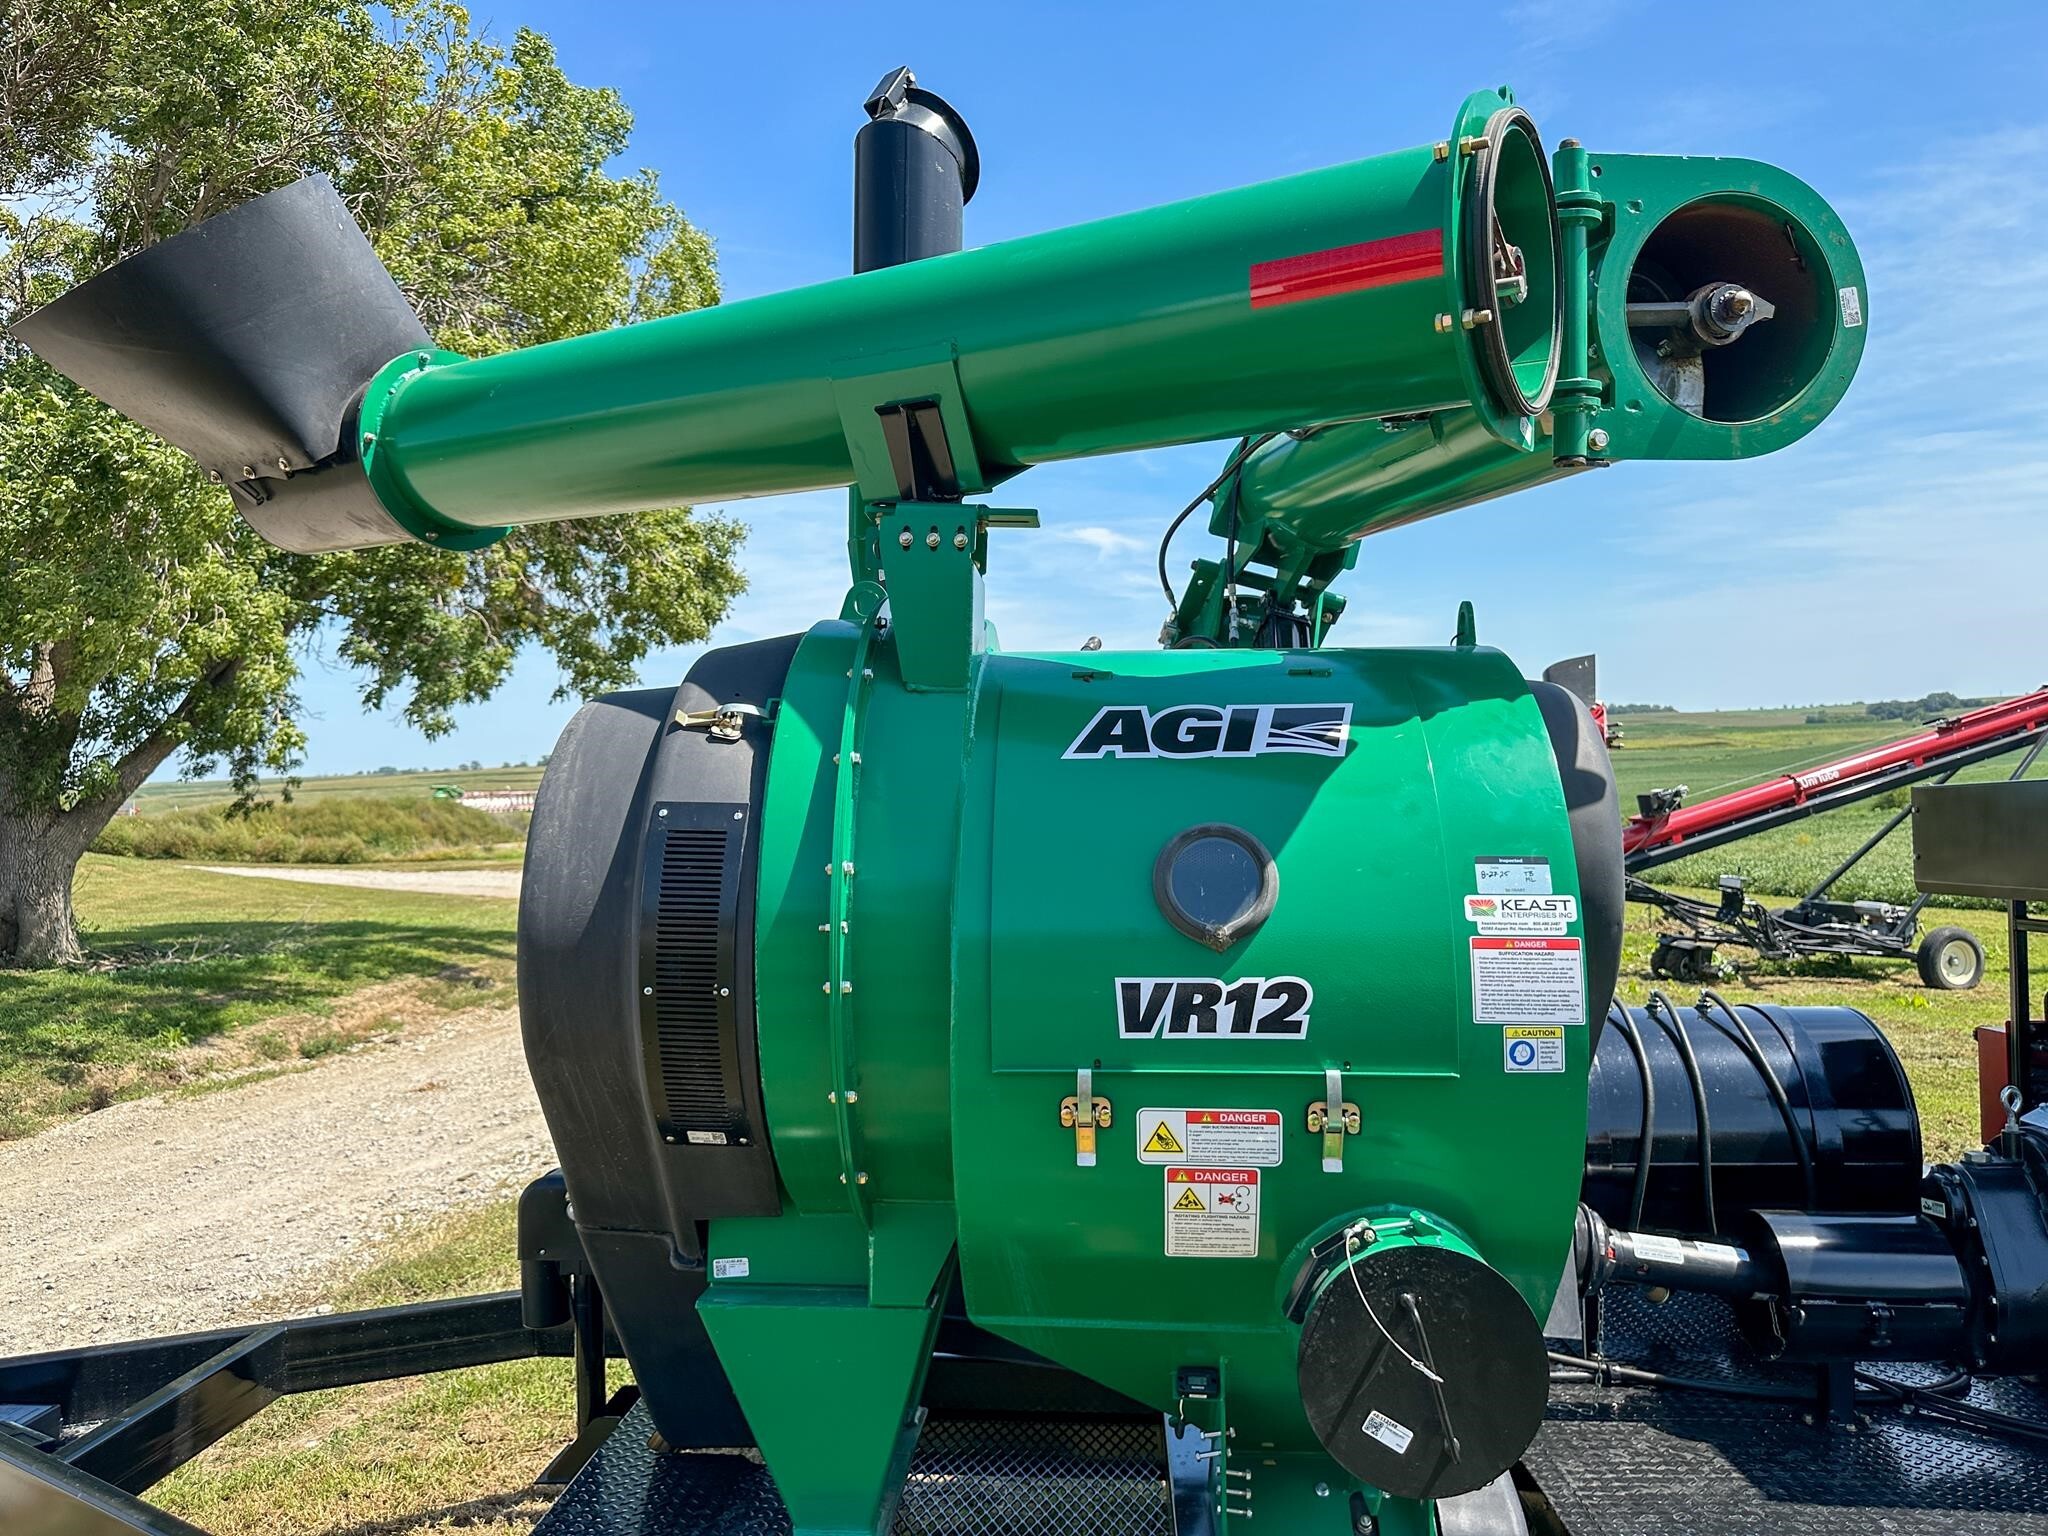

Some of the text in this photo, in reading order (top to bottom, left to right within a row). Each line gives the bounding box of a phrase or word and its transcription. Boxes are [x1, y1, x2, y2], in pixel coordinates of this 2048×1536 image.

[1069, 706, 1262, 756] AGI
[1501, 899, 1571, 911] KEAST
[1118, 980, 1309, 1034] VR12
[1220, 1114, 1266, 1122] DANGER
[1194, 1172, 1248, 1182] DANGER
